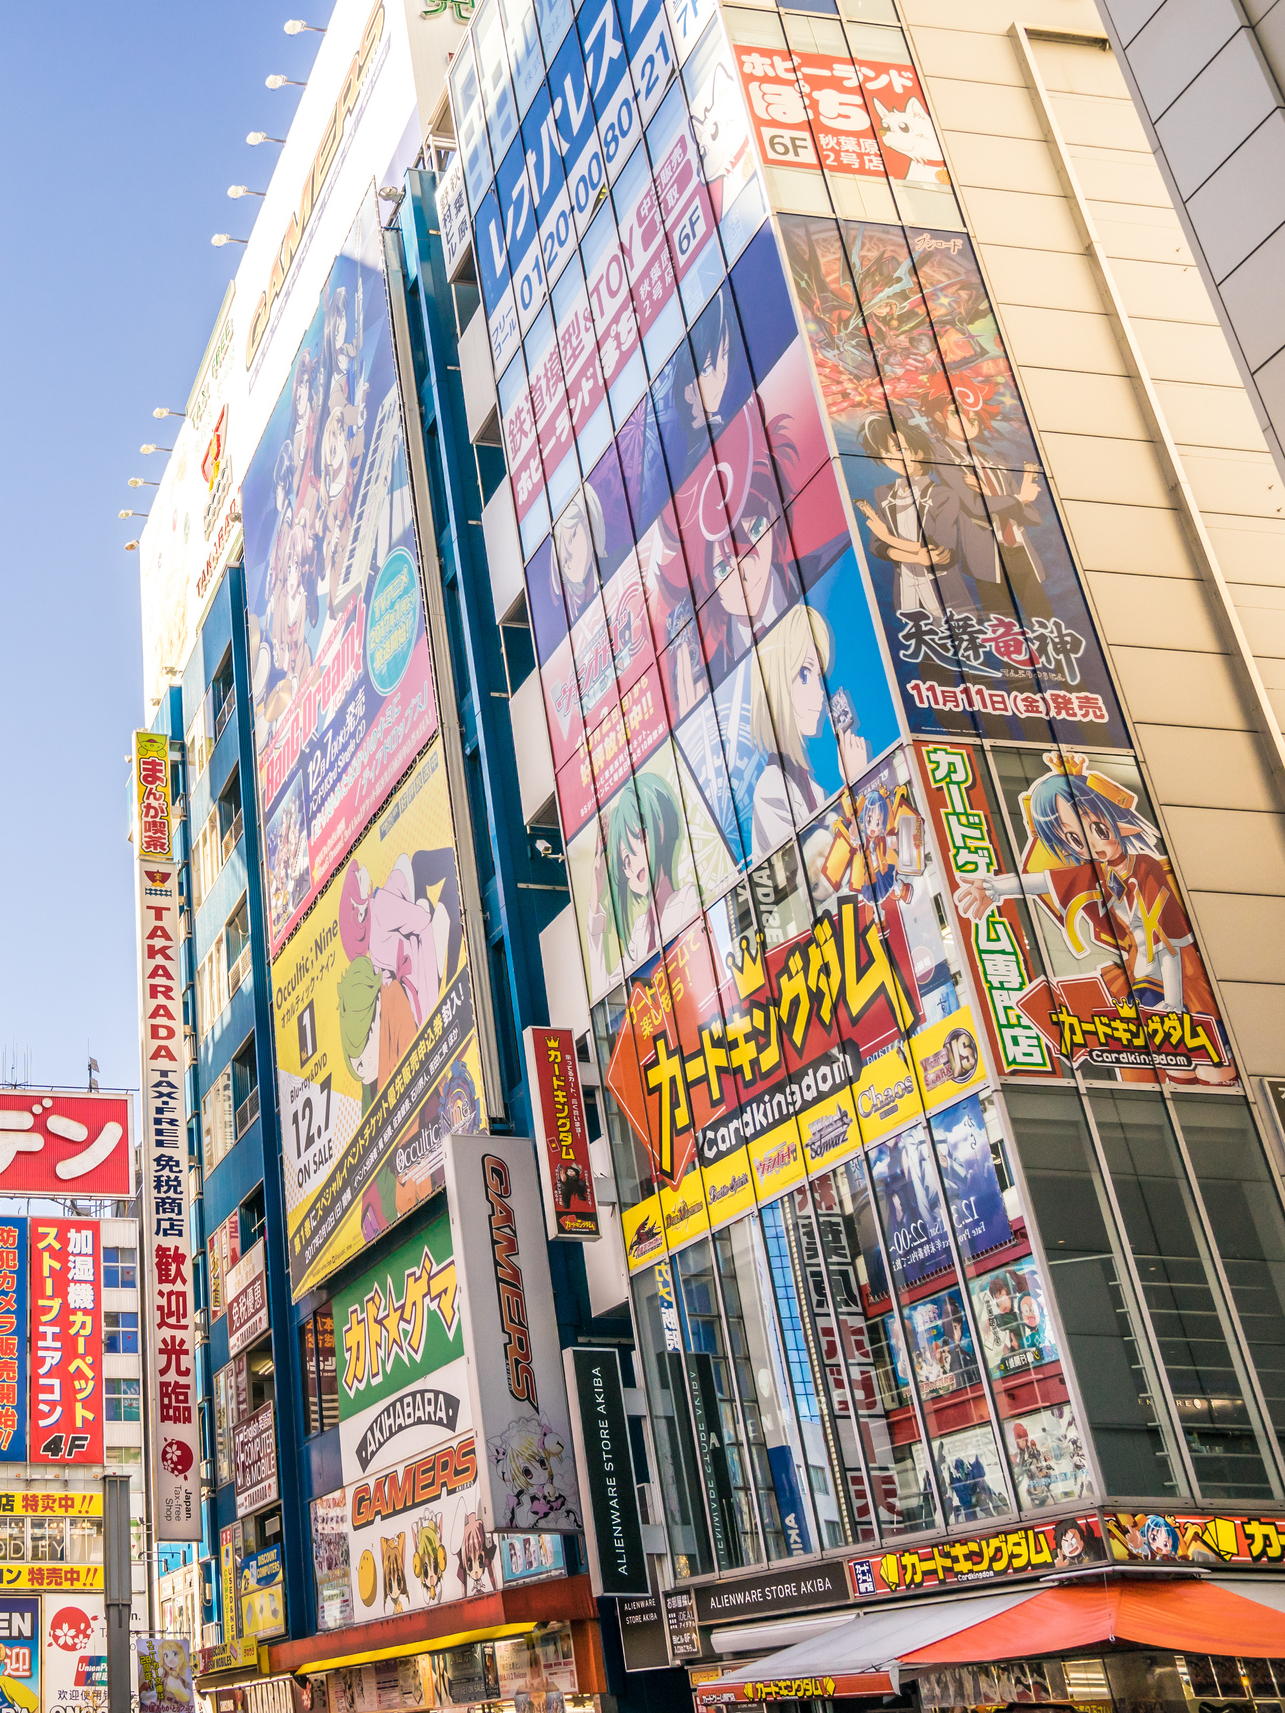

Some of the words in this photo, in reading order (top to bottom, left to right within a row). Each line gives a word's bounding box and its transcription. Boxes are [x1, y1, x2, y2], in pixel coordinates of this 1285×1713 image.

[740, 52, 914, 94] ホビーランド
[748, 80, 872, 132] ぽち
[767, 133, 810, 158] 6F
[818, 133, 882, 154] 秋葉原
[822, 150, 885, 172] 2号店
[678, 203, 703, 258] 6F
[590, 228, 637, 321] TOY
[492, 304, 516, 345] フリー
[493, 320, 518, 360] コール
[507, 309, 585, 465] 鉄道模型
[909, 682, 1110, 724] 11月11日(金)発売
[139, 757, 170, 855] まんが喫茶
[145, 905, 179, 1062] TAKARADA
[647, 903, 916, 1178] カードキングダム
[1051, 1006, 1225, 1066] カードキングダム
[290, 1072, 333, 1163] 12.7
[547, 1048, 576, 1161] カードキングダム
[856, 1073, 914, 1120] Chaos
[297, 1166, 312, 1190] ON
[312, 1145, 335, 1178] SALE
[153, 1153, 185, 1238] 免税商店
[480, 1153, 539, 1415] GAMERS
[37, 1226, 64, 1429] ストーブエアコン
[66, 1229, 96, 1430] 加湿機カーペット
[591, 1365, 607, 1414] AKIBA
[40, 1433, 90, 1460] 4F
[365, 1391, 448, 1464] AKIHABARA
[601, 1417, 617, 1470] STORE
[165, 1498, 173, 1521] Shop
[174, 1485, 182, 1522] Tax-free
[184, 1488, 194, 1522] Japan.
[351, 1437, 479, 1532] GAMERS
[603, 1472, 628, 1576] ALIENWARE
[257, 1548, 277, 1567] DISCOUNT
[902, 1528, 1054, 1586] カードキングダム
[623, 1597, 657, 1611] ALIENWARE
[625, 1613, 641, 1624] STORE
[642, 1611, 658, 1622] AKIBA
[709, 1588, 764, 1610] ALIENWARE
[765, 1583, 798, 1601] STORE
[800, 1577, 833, 1595] AKIBA
[755, 1678, 823, 1701] カードキングダム
